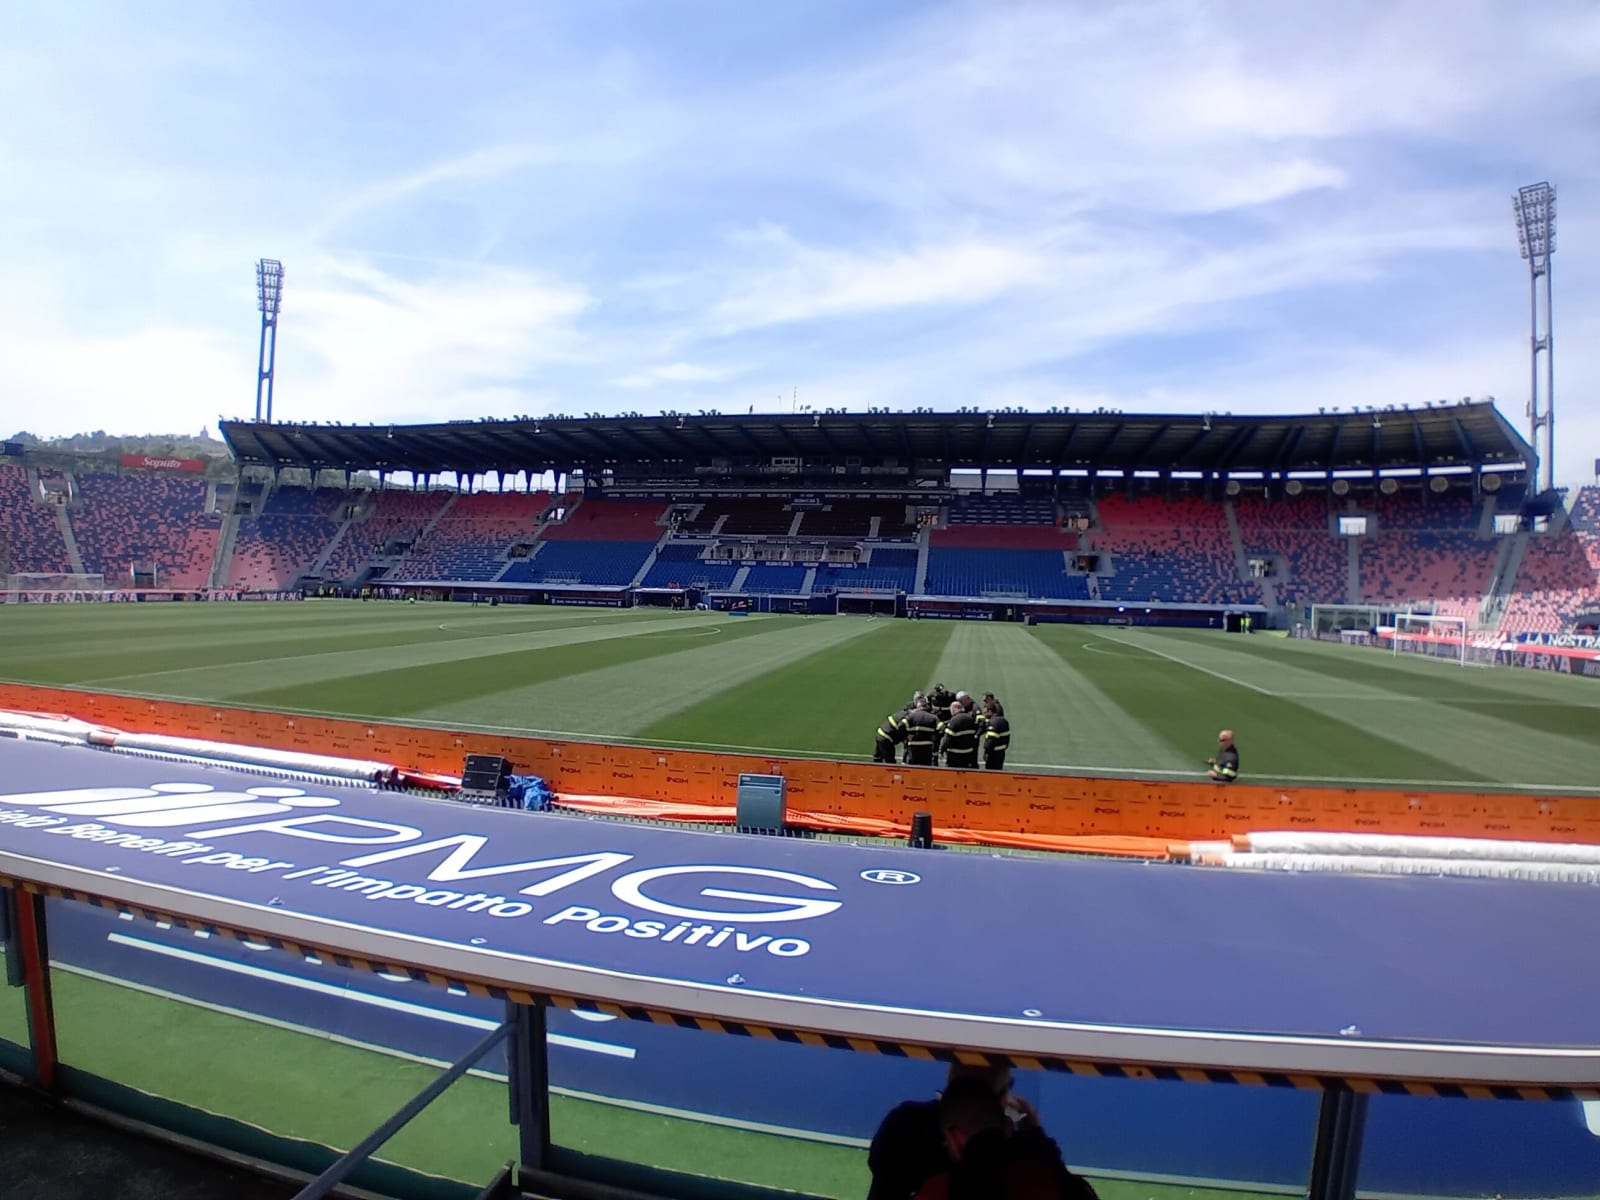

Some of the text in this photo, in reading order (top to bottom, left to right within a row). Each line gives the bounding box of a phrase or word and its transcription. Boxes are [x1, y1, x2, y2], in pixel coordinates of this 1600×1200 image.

[142, 456, 182, 468] Saputo
[1525, 632, 1543, 645] LA
[44, 824, 215, 858] Benefit
[181, 850, 295, 873] per
[283, 865, 533, 919] l'Impatto
[543, 905, 811, 958] Positivo
[184, 814, 843, 923] PMG
